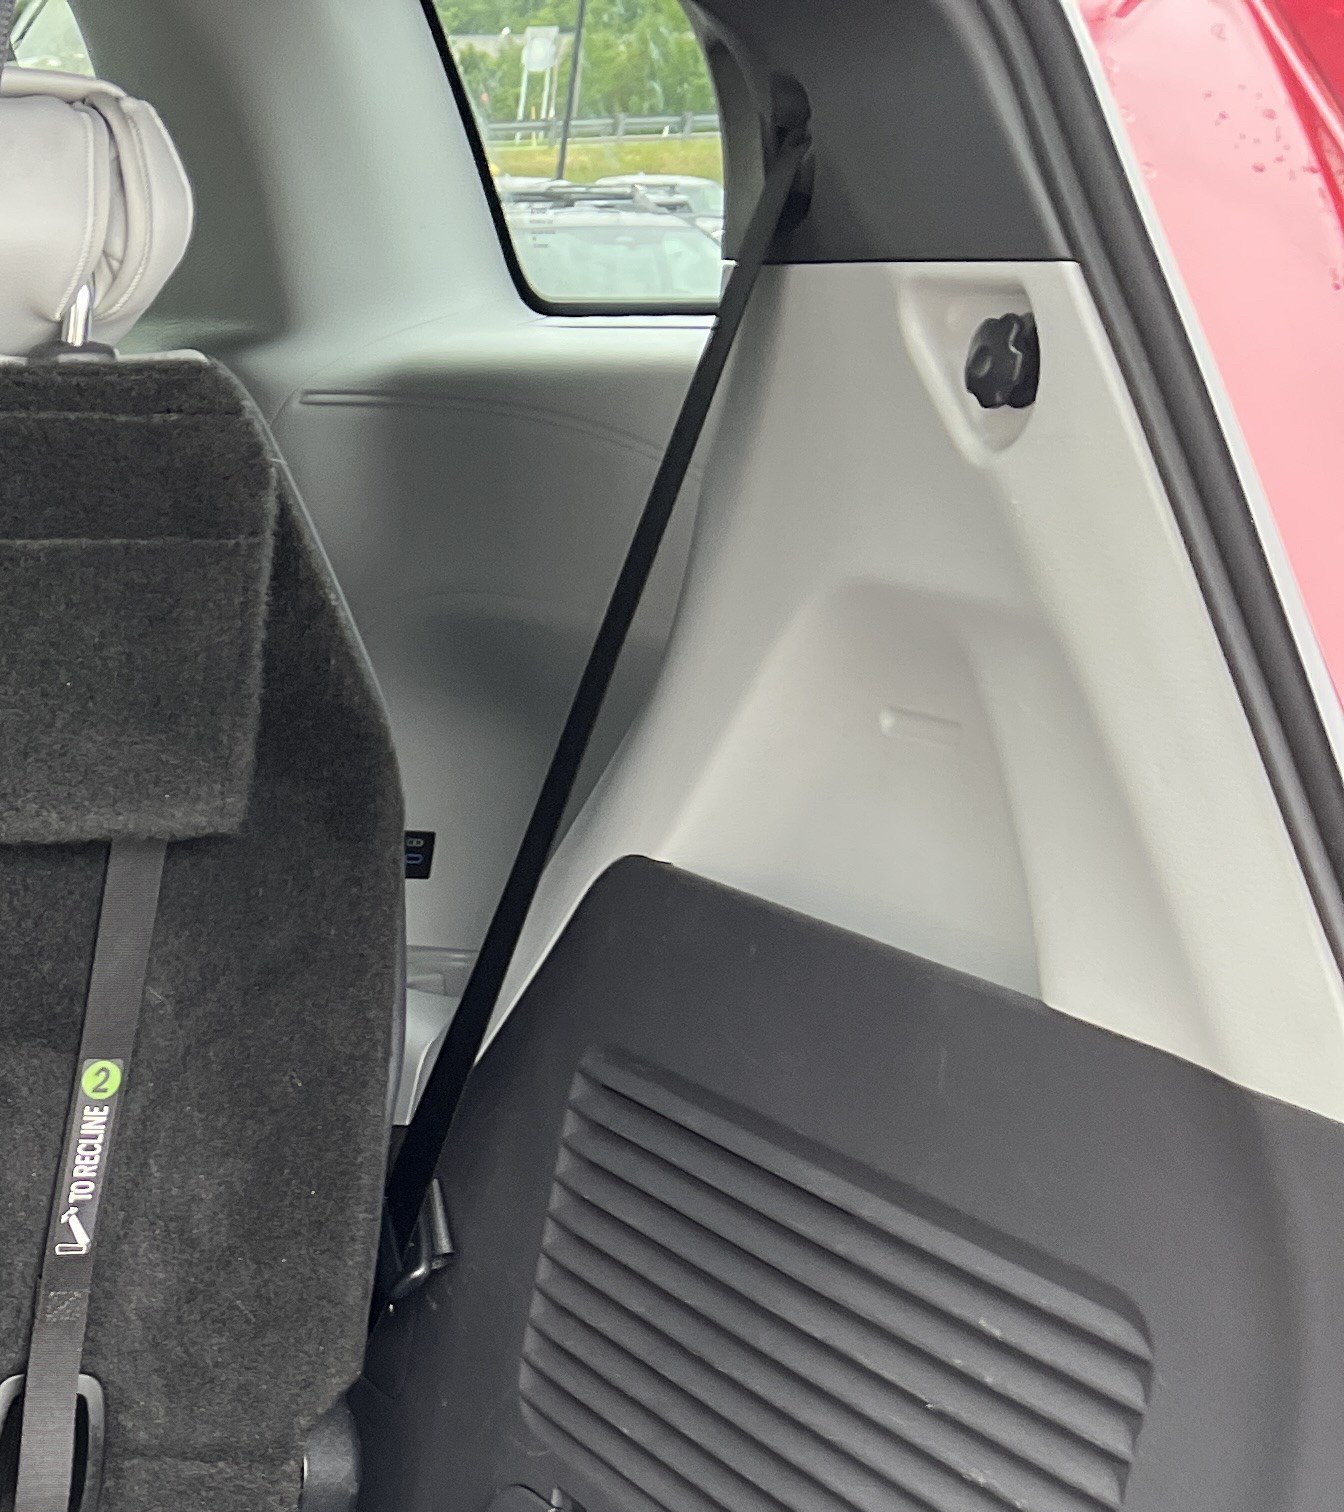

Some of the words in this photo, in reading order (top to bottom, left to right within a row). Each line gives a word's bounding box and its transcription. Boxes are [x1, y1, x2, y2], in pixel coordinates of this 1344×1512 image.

[91, 1066, 110, 1093] 2
[72, 1105, 109, 1178] RECLINE
[69, 1180, 95, 1204] TO
